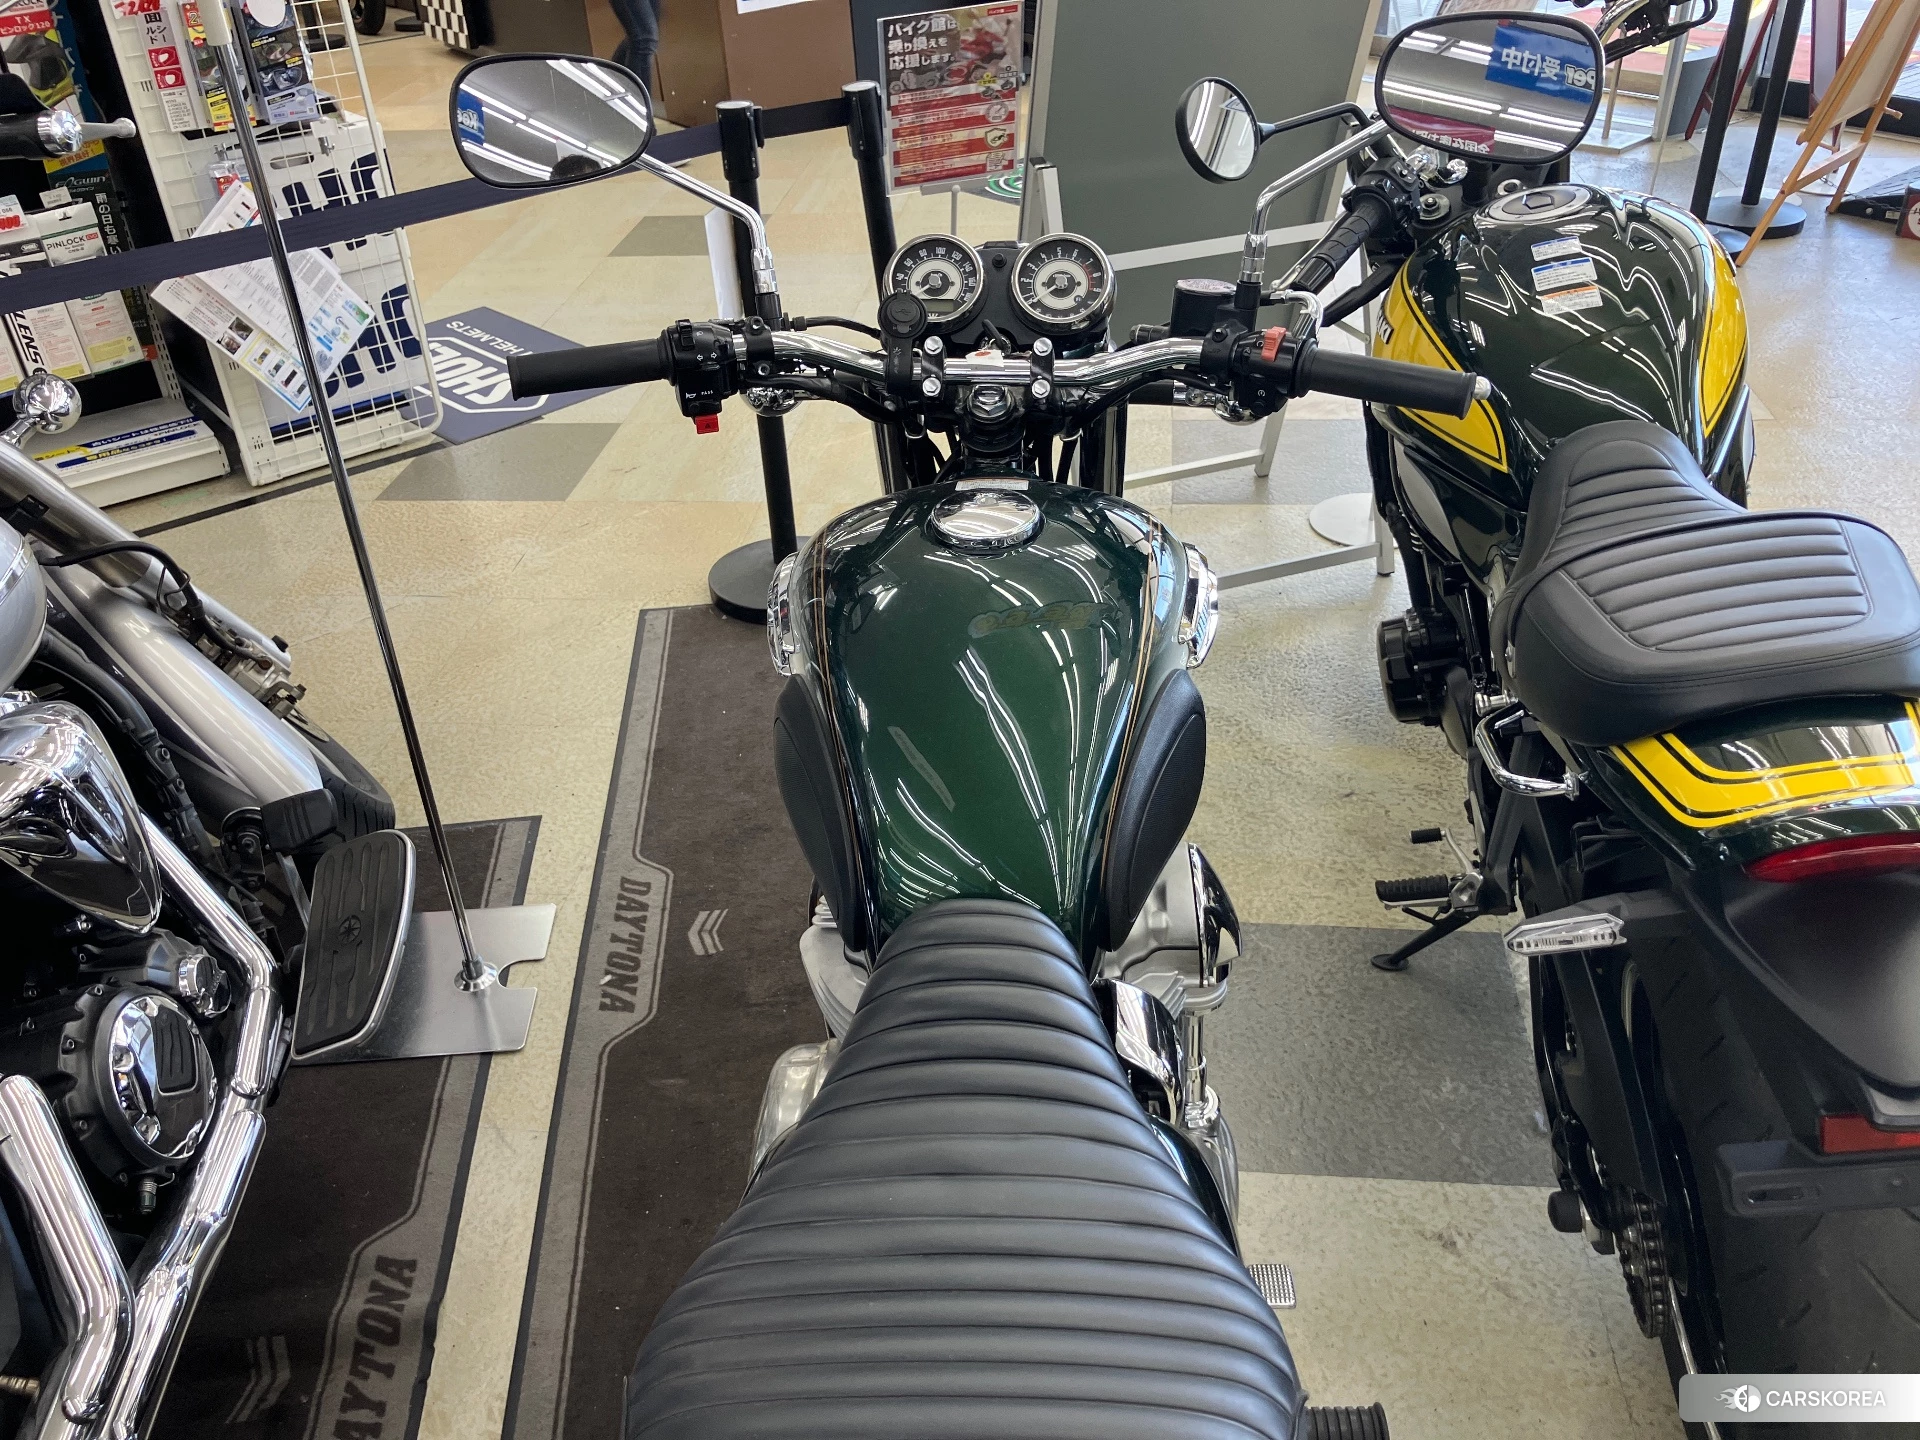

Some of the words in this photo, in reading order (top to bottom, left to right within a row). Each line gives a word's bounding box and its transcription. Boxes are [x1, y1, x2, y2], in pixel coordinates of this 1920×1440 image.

[15, 15, 31, 24] TX
[888, 17, 957, 38] バイク館は
[888, 36, 948, 54] 乗り換えを
[889, 53, 955, 70] 応援します。
[47, 235, 86, 250] PINLOCK
[935, 247, 946, 255] 100
[446, 321, 524, 355] HELMETS
[429, 342, 511, 405] SHO
[599, 876, 651, 1014] DAYTONA
[333, 1254, 417, 1440] AYTONA
